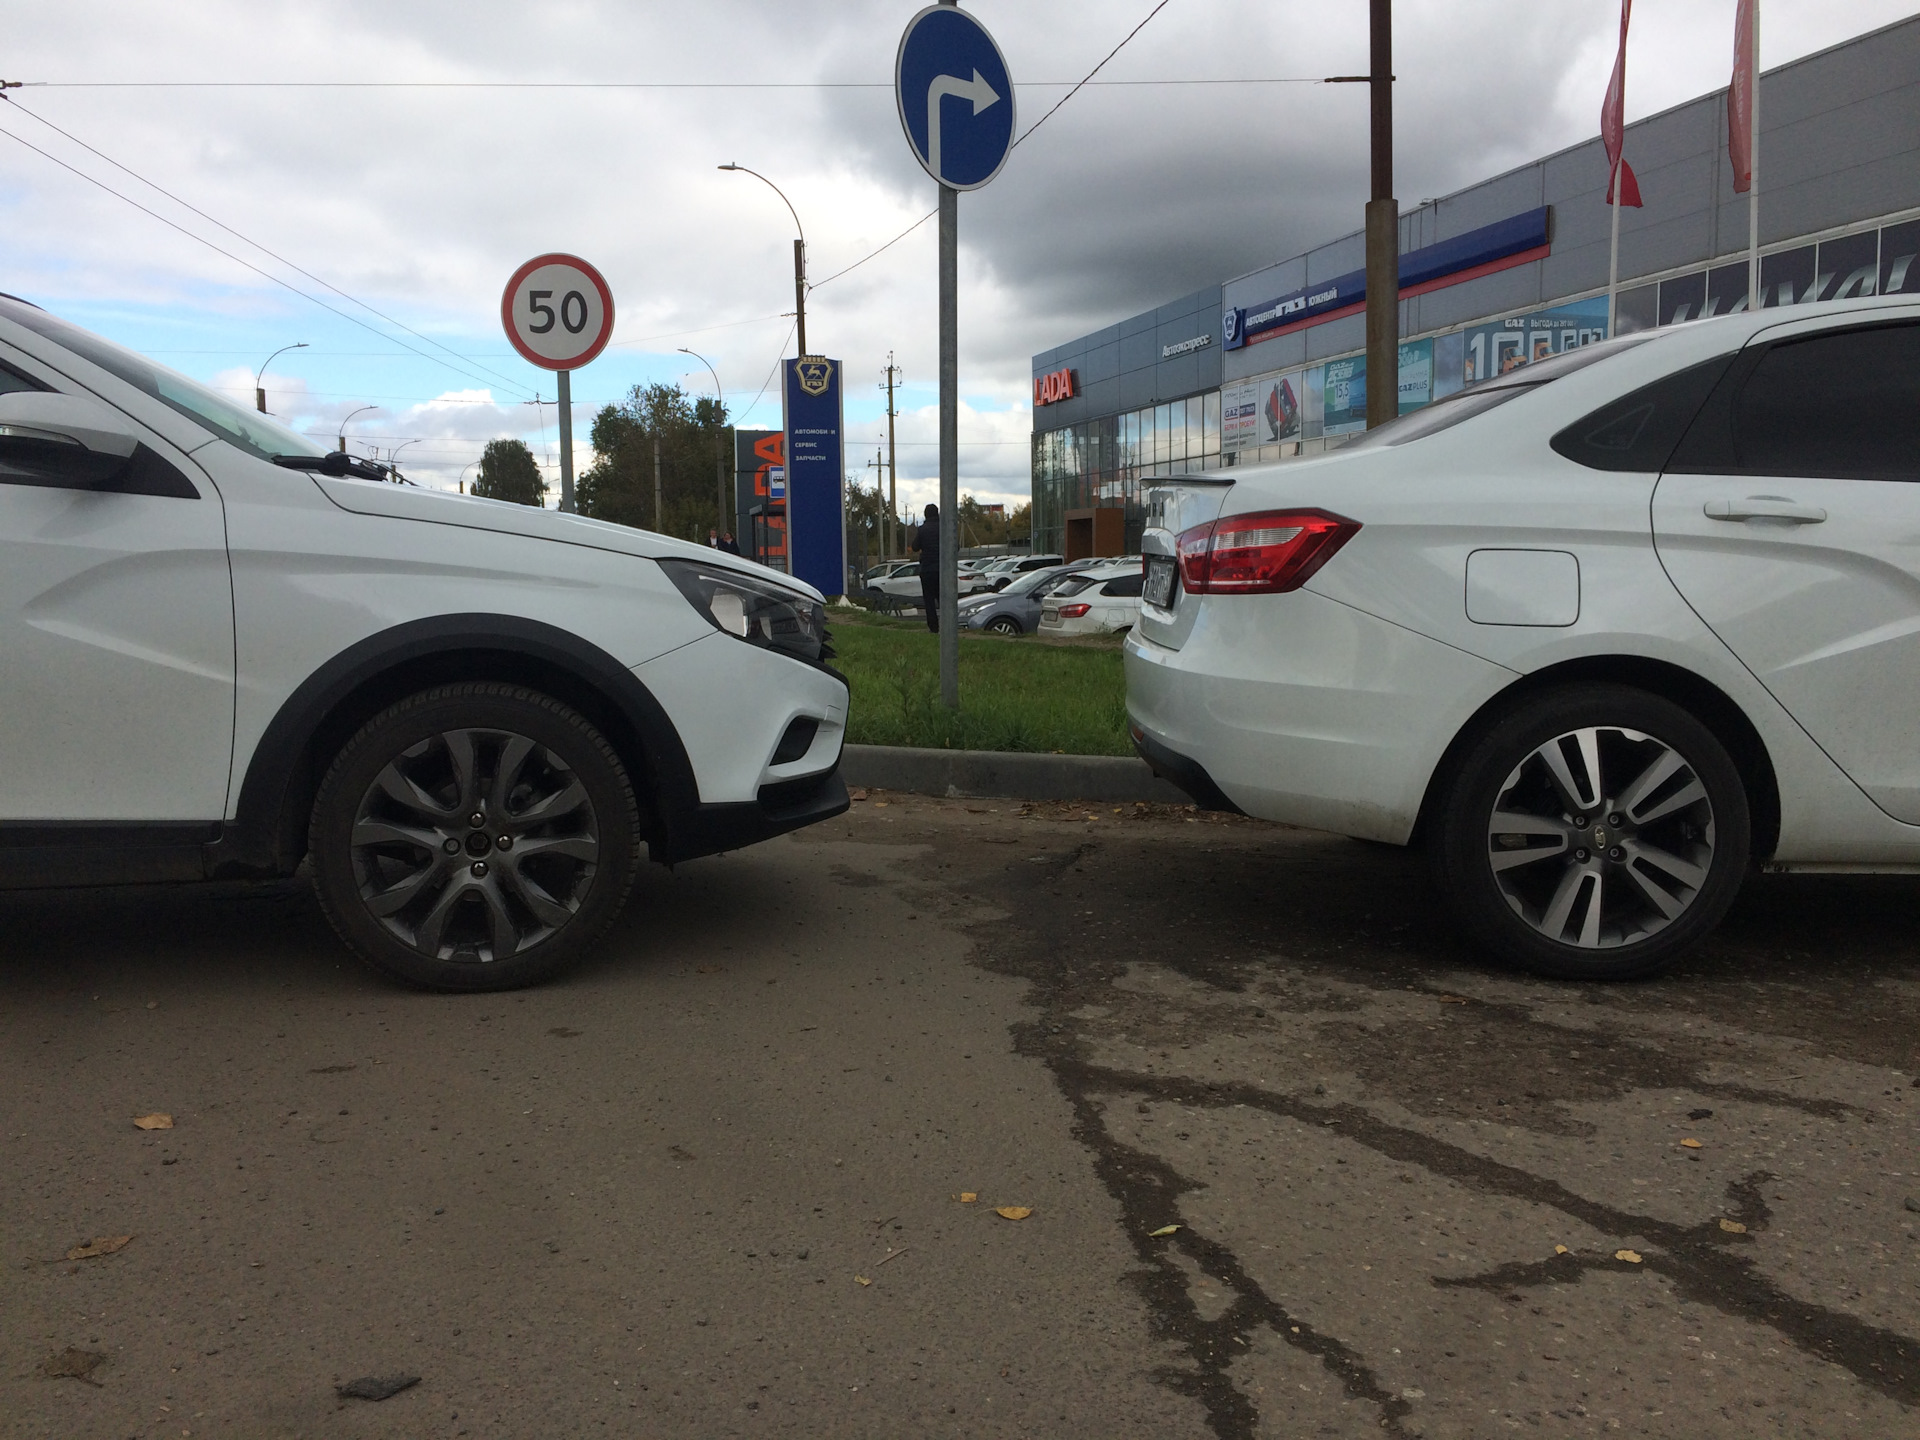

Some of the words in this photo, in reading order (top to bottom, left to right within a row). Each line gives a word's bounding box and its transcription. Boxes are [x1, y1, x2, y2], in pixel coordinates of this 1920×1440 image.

[529, 290, 588, 334] 50
[1245, 309, 1276, 328] АВТОЦЕНТР
[1275, 296, 1306, 317] ГАЗ
[1308, 286, 1338, 307] ЮЖНЫЙ
[1504, 318, 1525, 328] GAZ
[1530, 319, 1553, 328] ВЫГОДА
[1162, 334, 1210, 358] Автоэкспресс
[1034, 367, 1073, 406] LADA
[1224, 408, 1238, 418] GAZ
